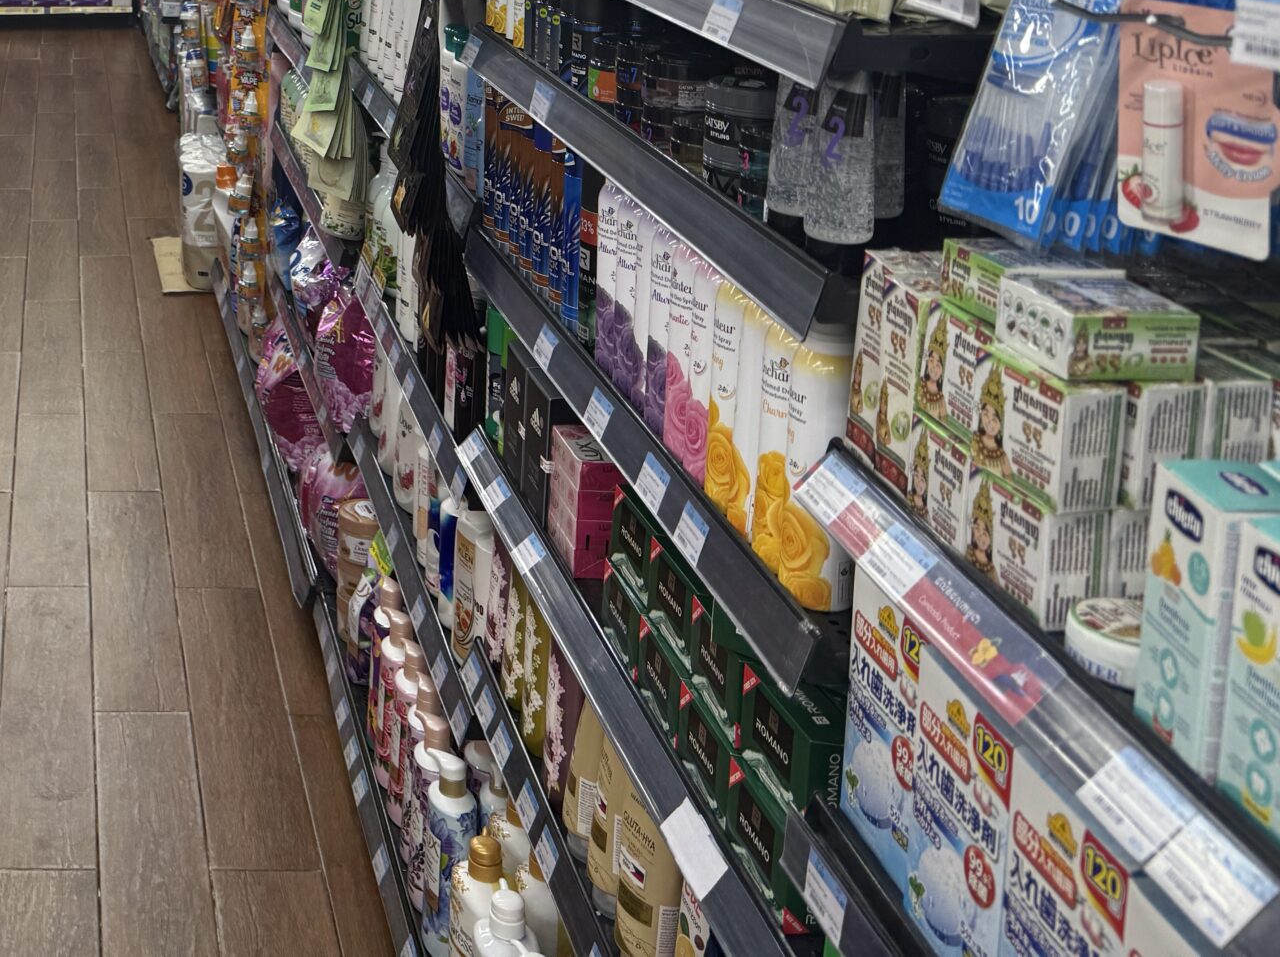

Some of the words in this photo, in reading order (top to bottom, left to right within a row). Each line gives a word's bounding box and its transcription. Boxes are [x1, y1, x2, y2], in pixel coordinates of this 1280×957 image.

[1132, 32, 1214, 70] LipIce
[705, 115, 729, 131] GATSBY
[710, 130, 729, 141] STYLING
[1202, 208, 1263, 230] STRAWBERRY
[621, 525, 642, 557] ROMANO
[609, 600, 628, 635] ROMANO
[659, 581, 682, 618] ROMANO
[942, 619, 961, 640] Product
[646, 659, 667, 700] ROMANO
[700, 641, 725, 686] ROMANO
[688, 730, 714, 775] ROMANO
[755, 719, 790, 765] ROMANO
[976, 727, 1007, 773] 120
[830, 753, 841, 809] OMANO
[738, 814, 770, 863] ROMANO
[1085, 846, 1121, 898] 120
